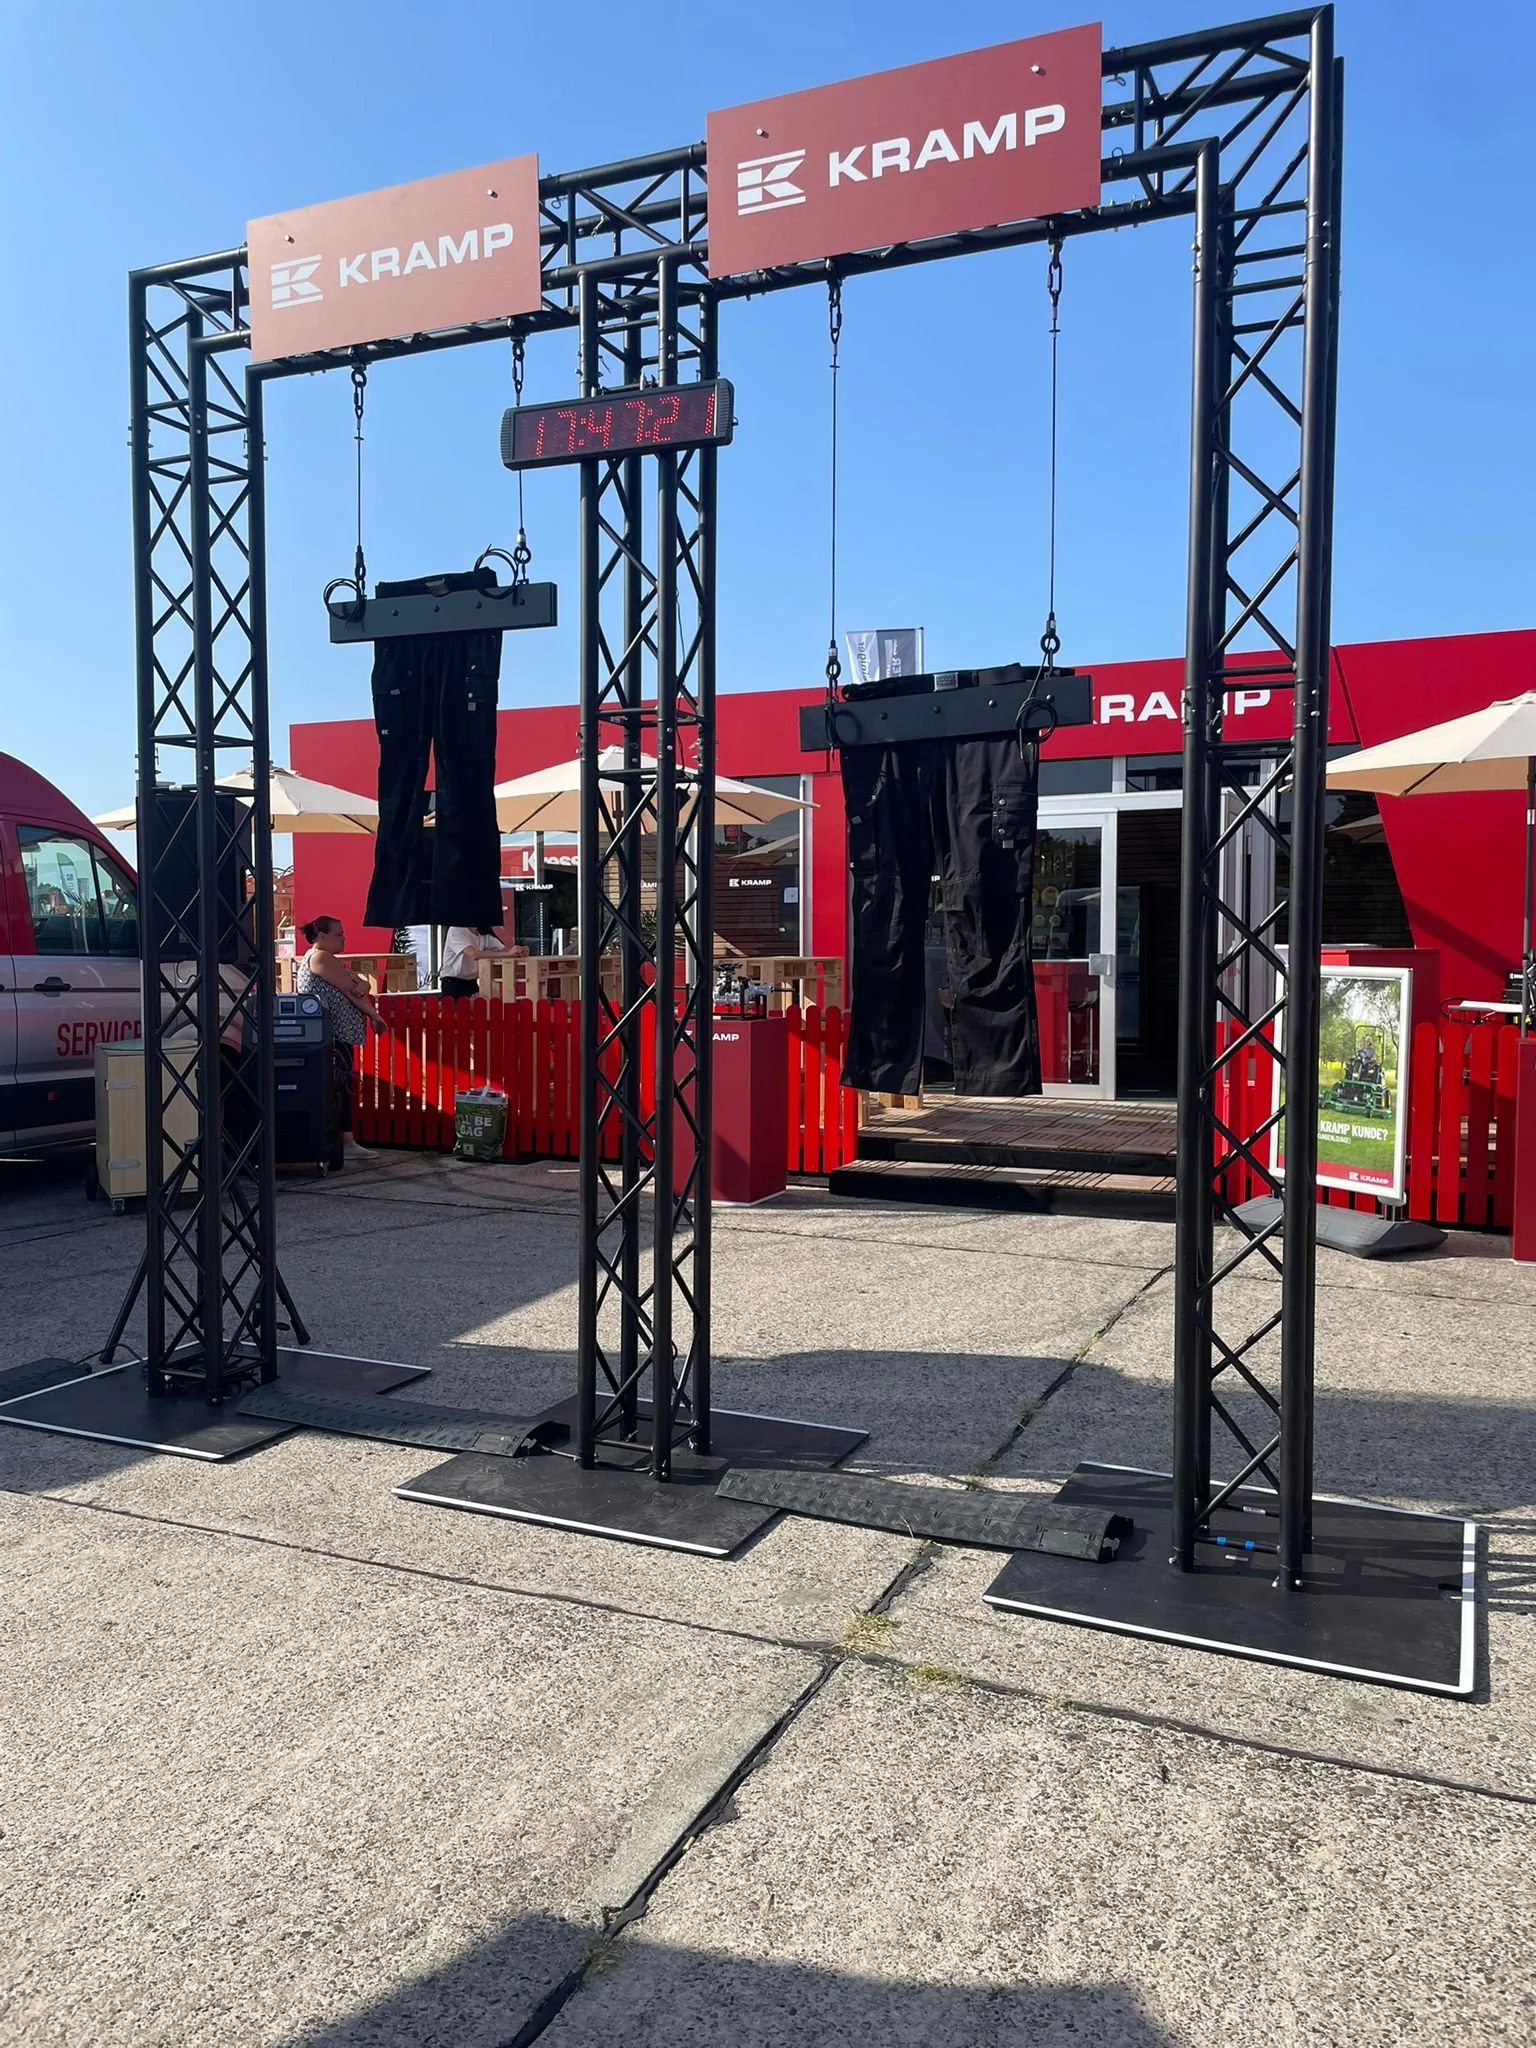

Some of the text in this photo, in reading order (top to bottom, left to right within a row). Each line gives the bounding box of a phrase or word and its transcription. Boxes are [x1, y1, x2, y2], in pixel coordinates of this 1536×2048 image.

[829, 103, 1066, 187] KRAMP
[339, 223, 513, 288] KRAMP
[536, 392, 716, 457] 17:47:21
[1092, 689, 1271, 725] RAP
[474, 1116, 493, 1127] BE
[1320, 1120, 1350, 1135] KRAMP
[1352, 1125, 1389, 1141] KUNDE?
[1360, 1175, 1389, 1185] KRAMP
